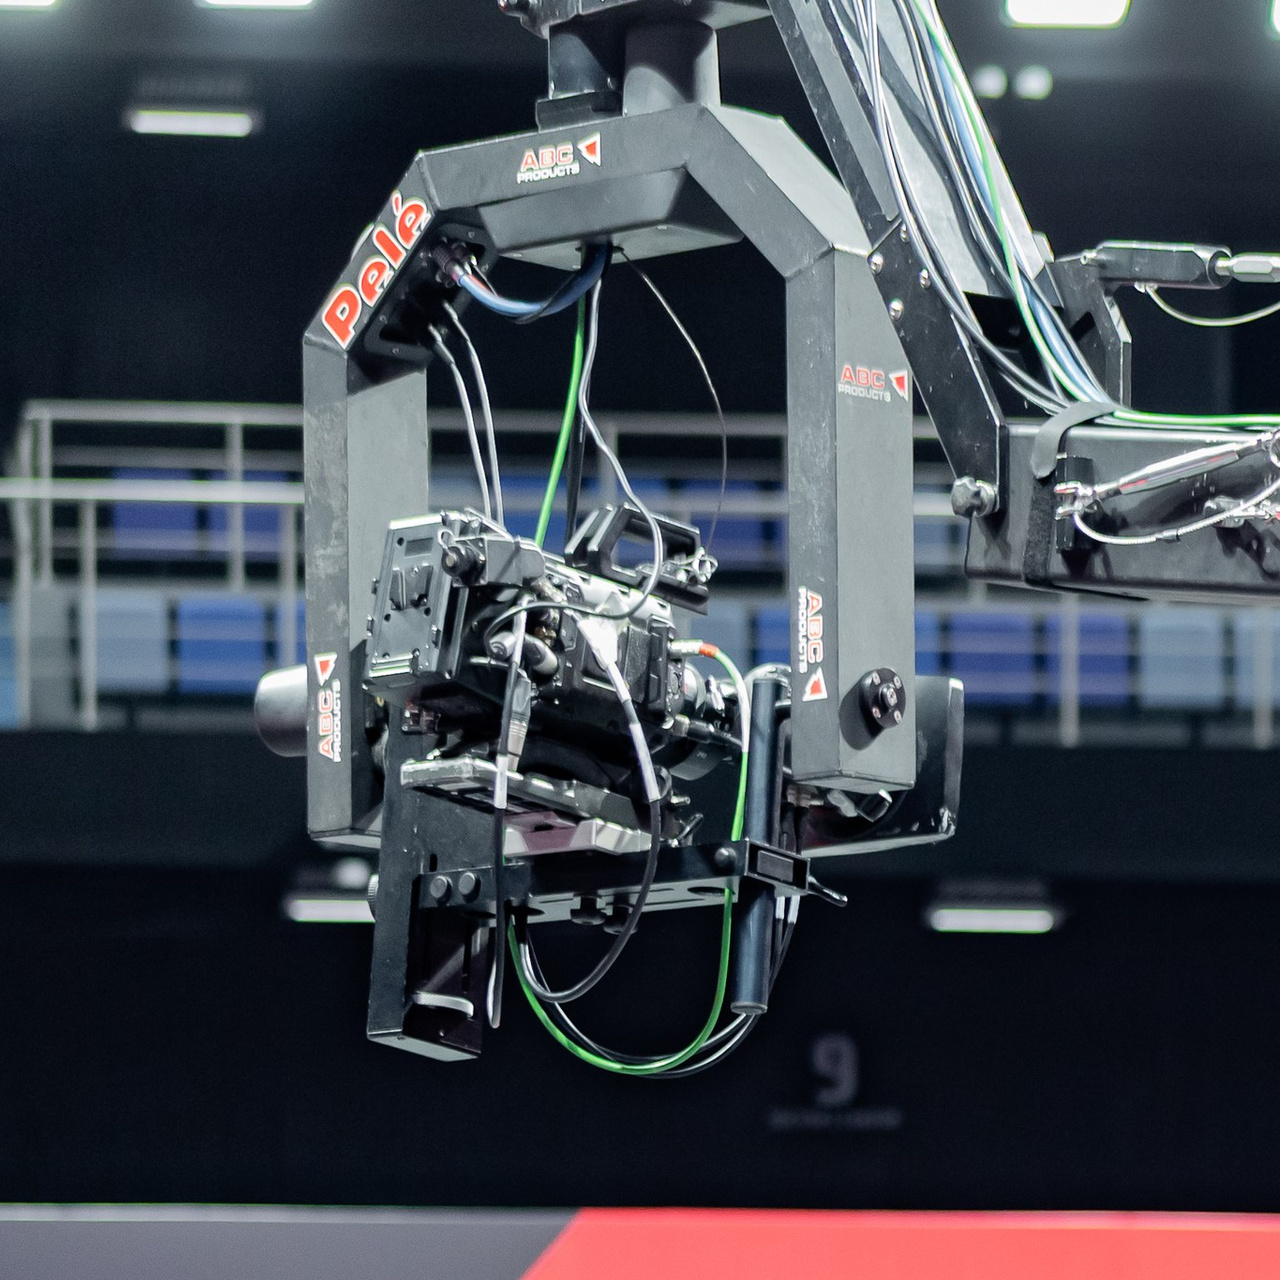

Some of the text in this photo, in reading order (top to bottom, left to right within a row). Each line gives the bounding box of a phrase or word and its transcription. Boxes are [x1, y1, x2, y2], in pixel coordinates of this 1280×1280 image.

[517, 161, 580, 184] PRODUCTS
[520, 142, 574, 172] ABC
[322, 190, 432, 350] Pelé
[838, 383, 891, 403] PRODUCTS
[841, 364, 885, 389] ABC
[798, 585, 808, 674] PRODUCTS
[807, 589, 823, 664] ABC
[318, 687, 334, 760] ABC
[332, 678, 341, 762] PRODUCTS
